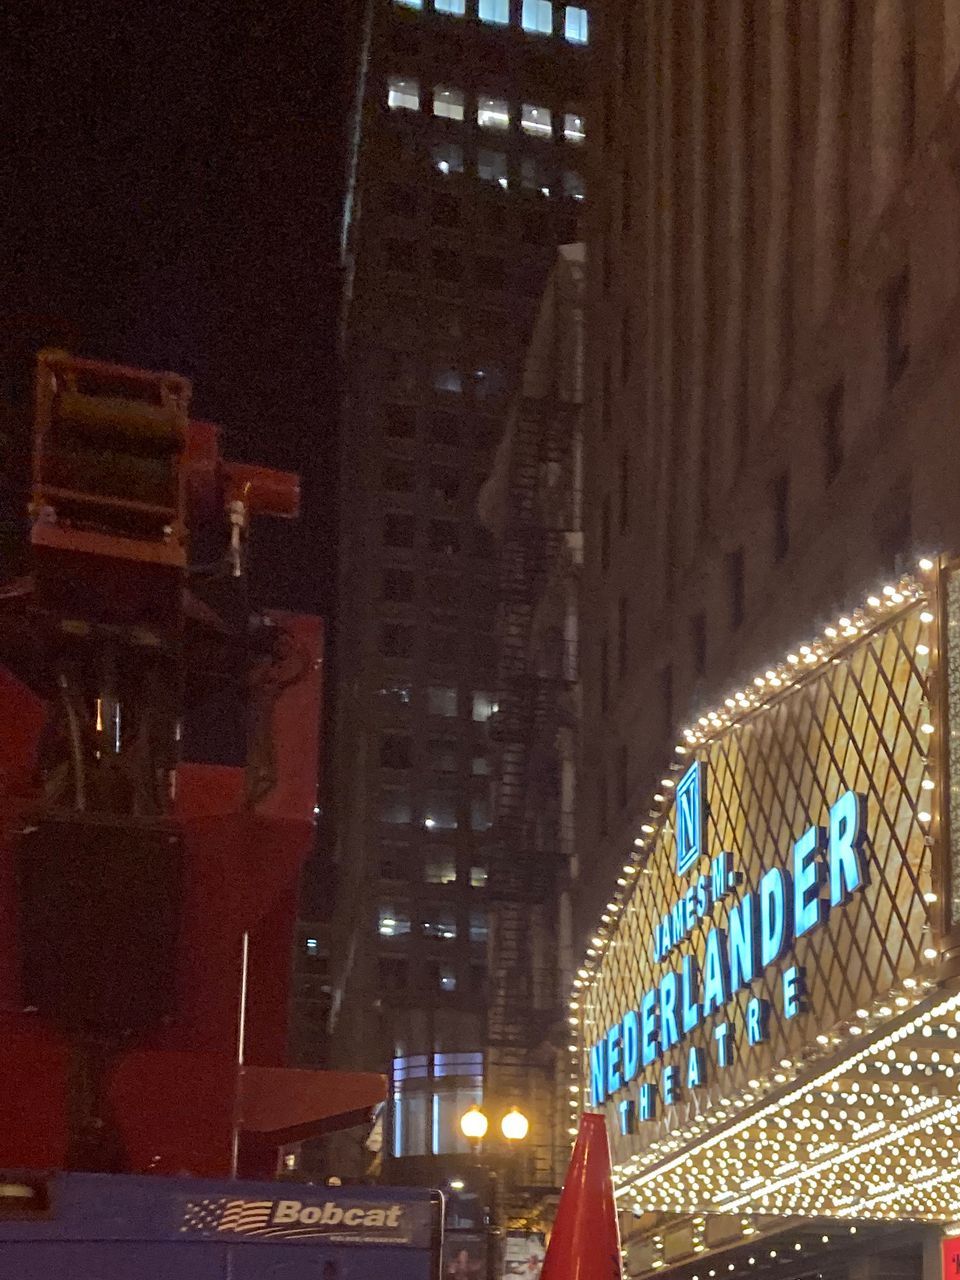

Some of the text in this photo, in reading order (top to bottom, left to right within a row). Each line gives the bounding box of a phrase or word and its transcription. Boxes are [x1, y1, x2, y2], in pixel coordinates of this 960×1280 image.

[590, 788, 862, 1107] NEDERLANDER
[653, 872, 707, 963] JAMES
[618, 965, 799, 1136] THEATRE
[272, 1199, 403, 1227] Bobcat
